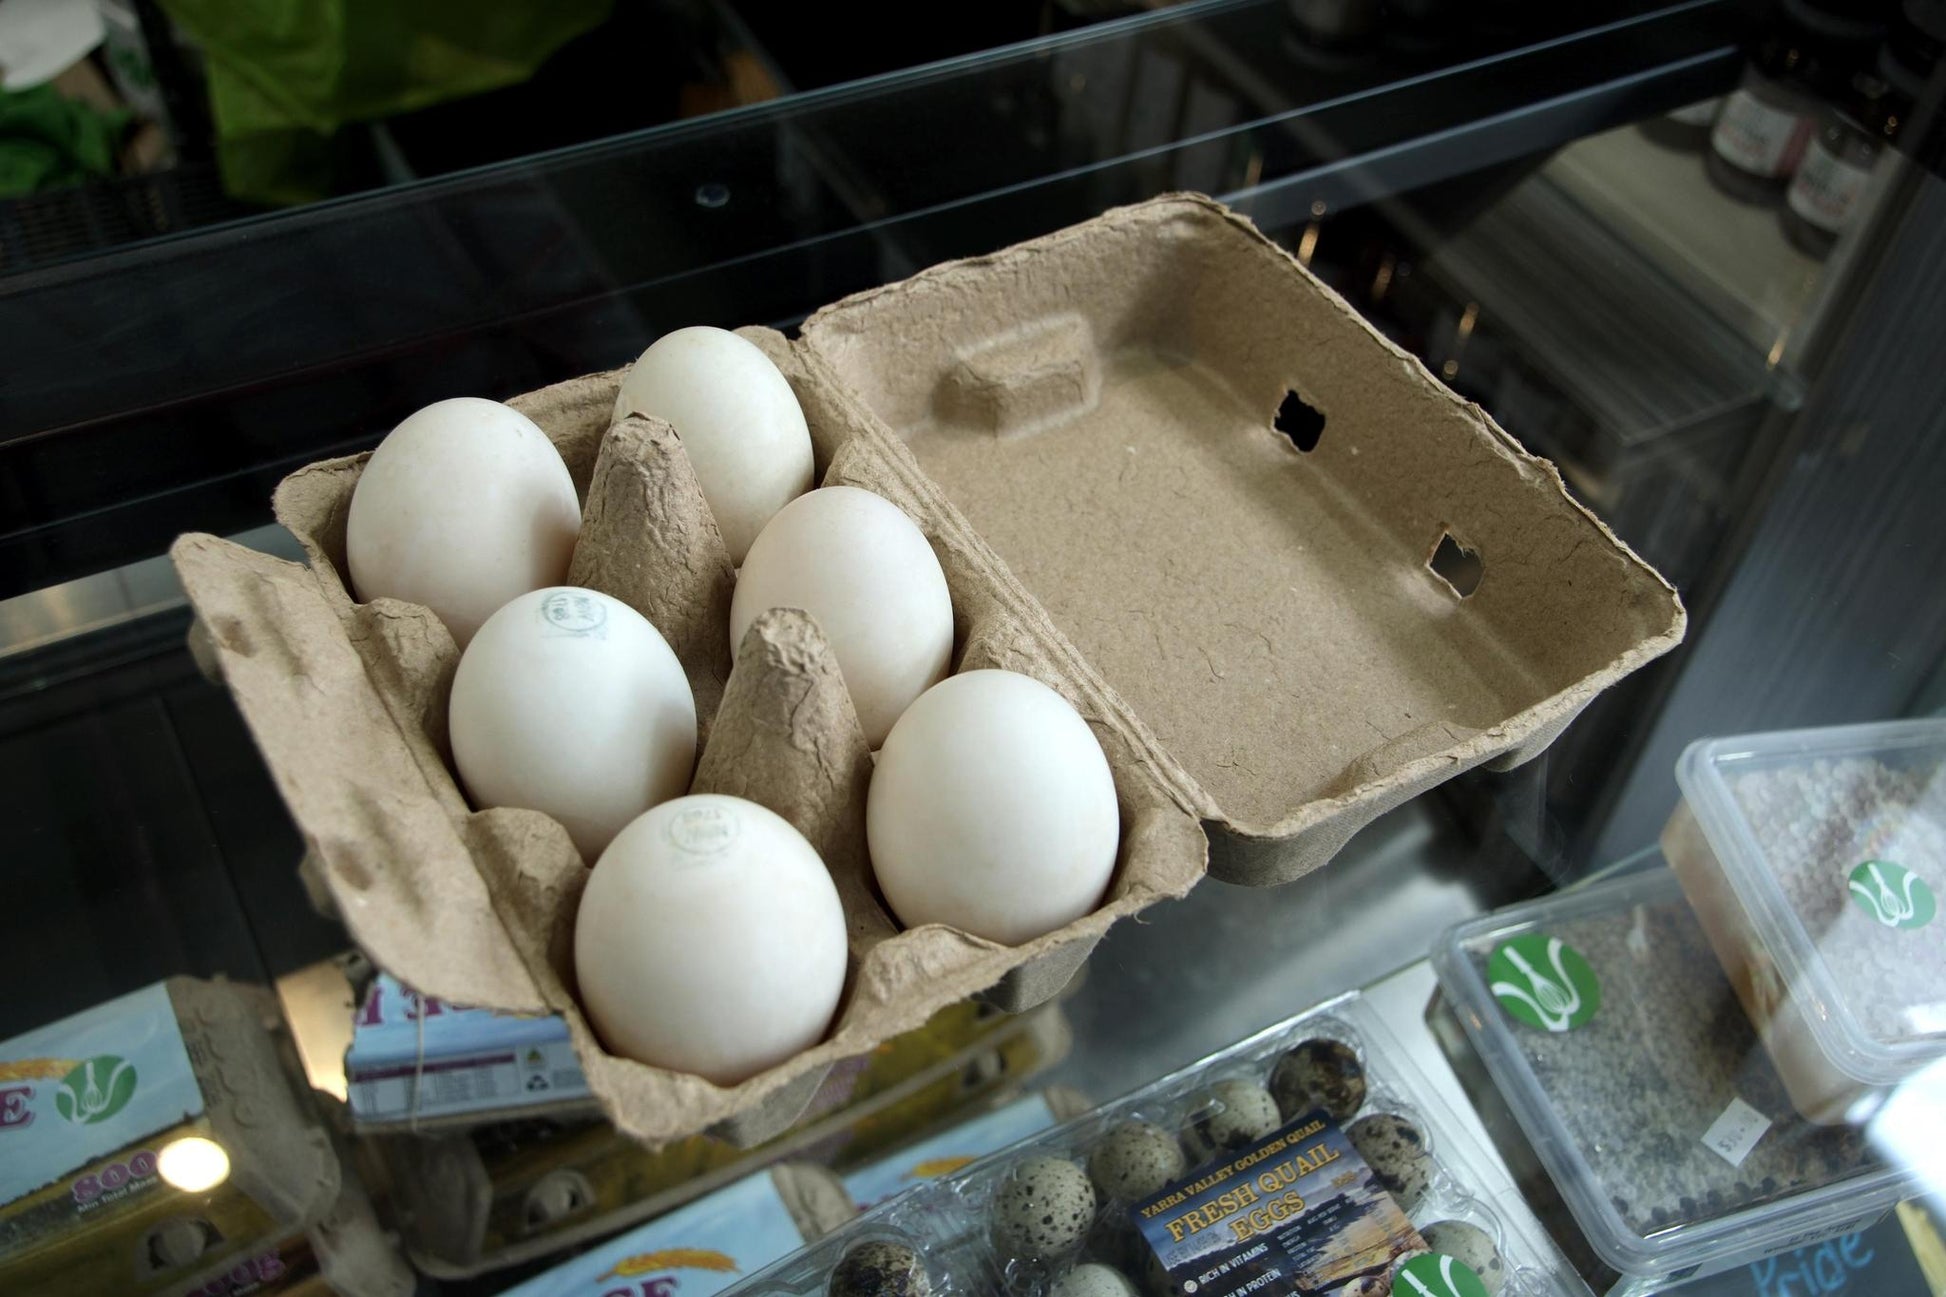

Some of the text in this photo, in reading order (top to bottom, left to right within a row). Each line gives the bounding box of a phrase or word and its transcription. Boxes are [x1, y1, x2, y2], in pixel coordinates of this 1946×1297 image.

[1141, 1120, 1326, 1219] YARRA VALLEY GOLDEN QUAIL
[1165, 1143, 1340, 1243] FRESH QUAIL
[1229, 1190, 1306, 1243] EGGS
[1198, 1268, 1221, 1285] RICH
[1218, 1262, 1231, 1274] IN
[1228, 1242, 1269, 1269] VITAMINS
[1245, 1268, 1283, 1293] PROTEIN
